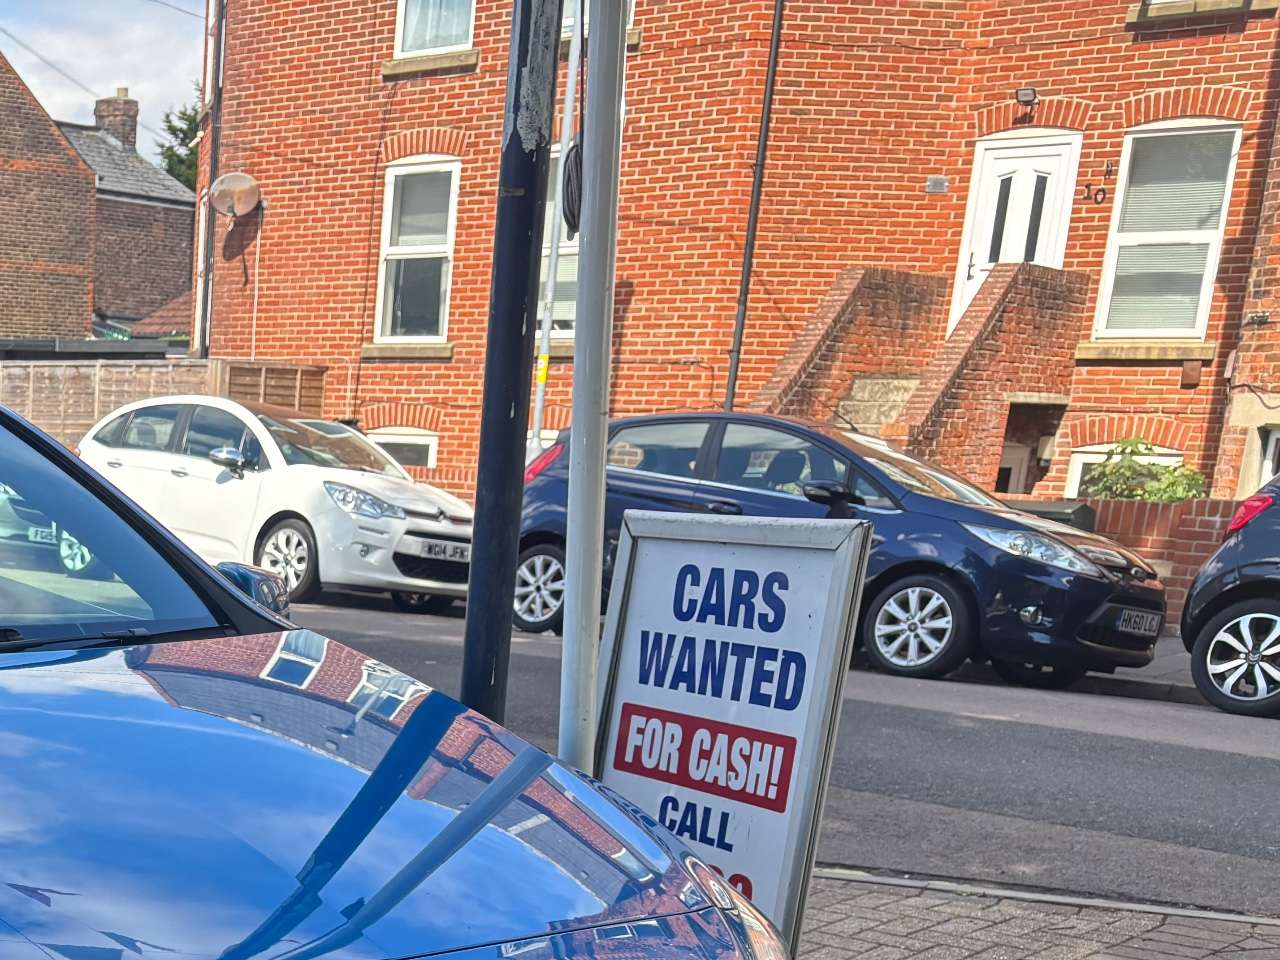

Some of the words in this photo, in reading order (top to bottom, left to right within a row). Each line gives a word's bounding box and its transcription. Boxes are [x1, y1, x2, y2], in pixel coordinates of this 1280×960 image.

[672, 564, 790, 633] CARS
[638, 630, 807, 711] WANTED
[624, 714, 683, 775] FOR
[688, 728, 785, 800] CASH!
[658, 795, 734, 852] CALL
